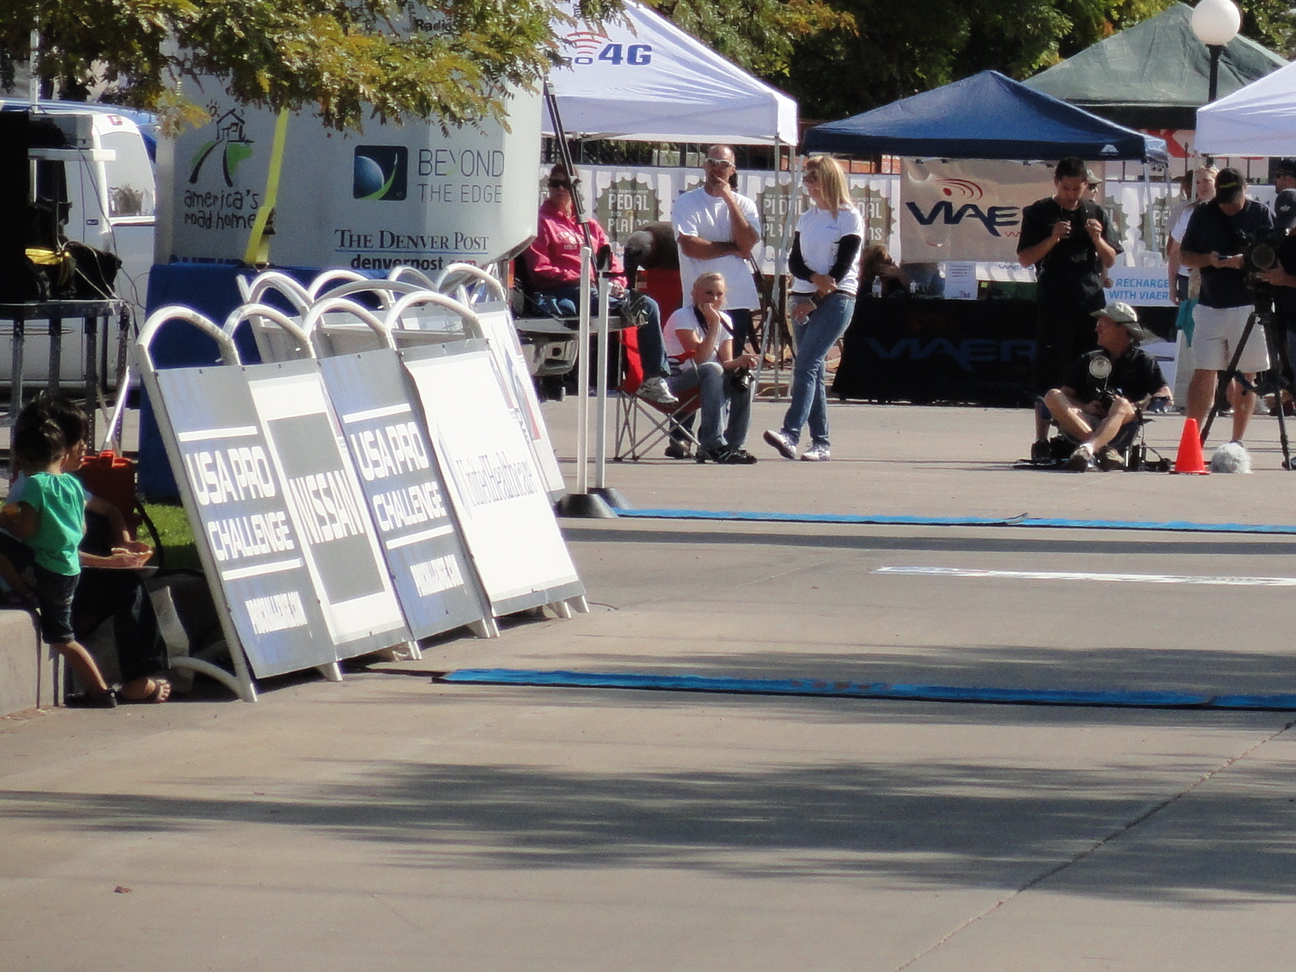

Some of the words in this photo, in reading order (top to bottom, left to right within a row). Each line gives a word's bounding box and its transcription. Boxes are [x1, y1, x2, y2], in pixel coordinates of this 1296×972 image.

[598, 44, 653, 65] 4G
[418, 149, 505, 177] BEYOND
[184, 189, 259, 210] america's
[419, 184, 453, 202] THE
[460, 184, 503, 203] EDGE
[608, 194, 650, 211] PEDAL
[184, 211, 213, 230] road
[215, 212, 256, 229] home
[334, 229, 374, 248] THE
[379, 230, 449, 249] DENVER
[454, 231, 489, 250] POST
[1116, 279, 1169, 288] RECHARGE
[1109, 290, 1136, 300] WITH
[350, 429, 397, 481] USA
[385, 422, 430, 474] PRO
[185, 450, 238, 505] USA
[227, 446, 275, 500] PRO
[289, 469, 364, 545] NISSAN
[373, 481, 447, 531] CHALLENGE
[208, 511, 294, 561] CHALLENGE
